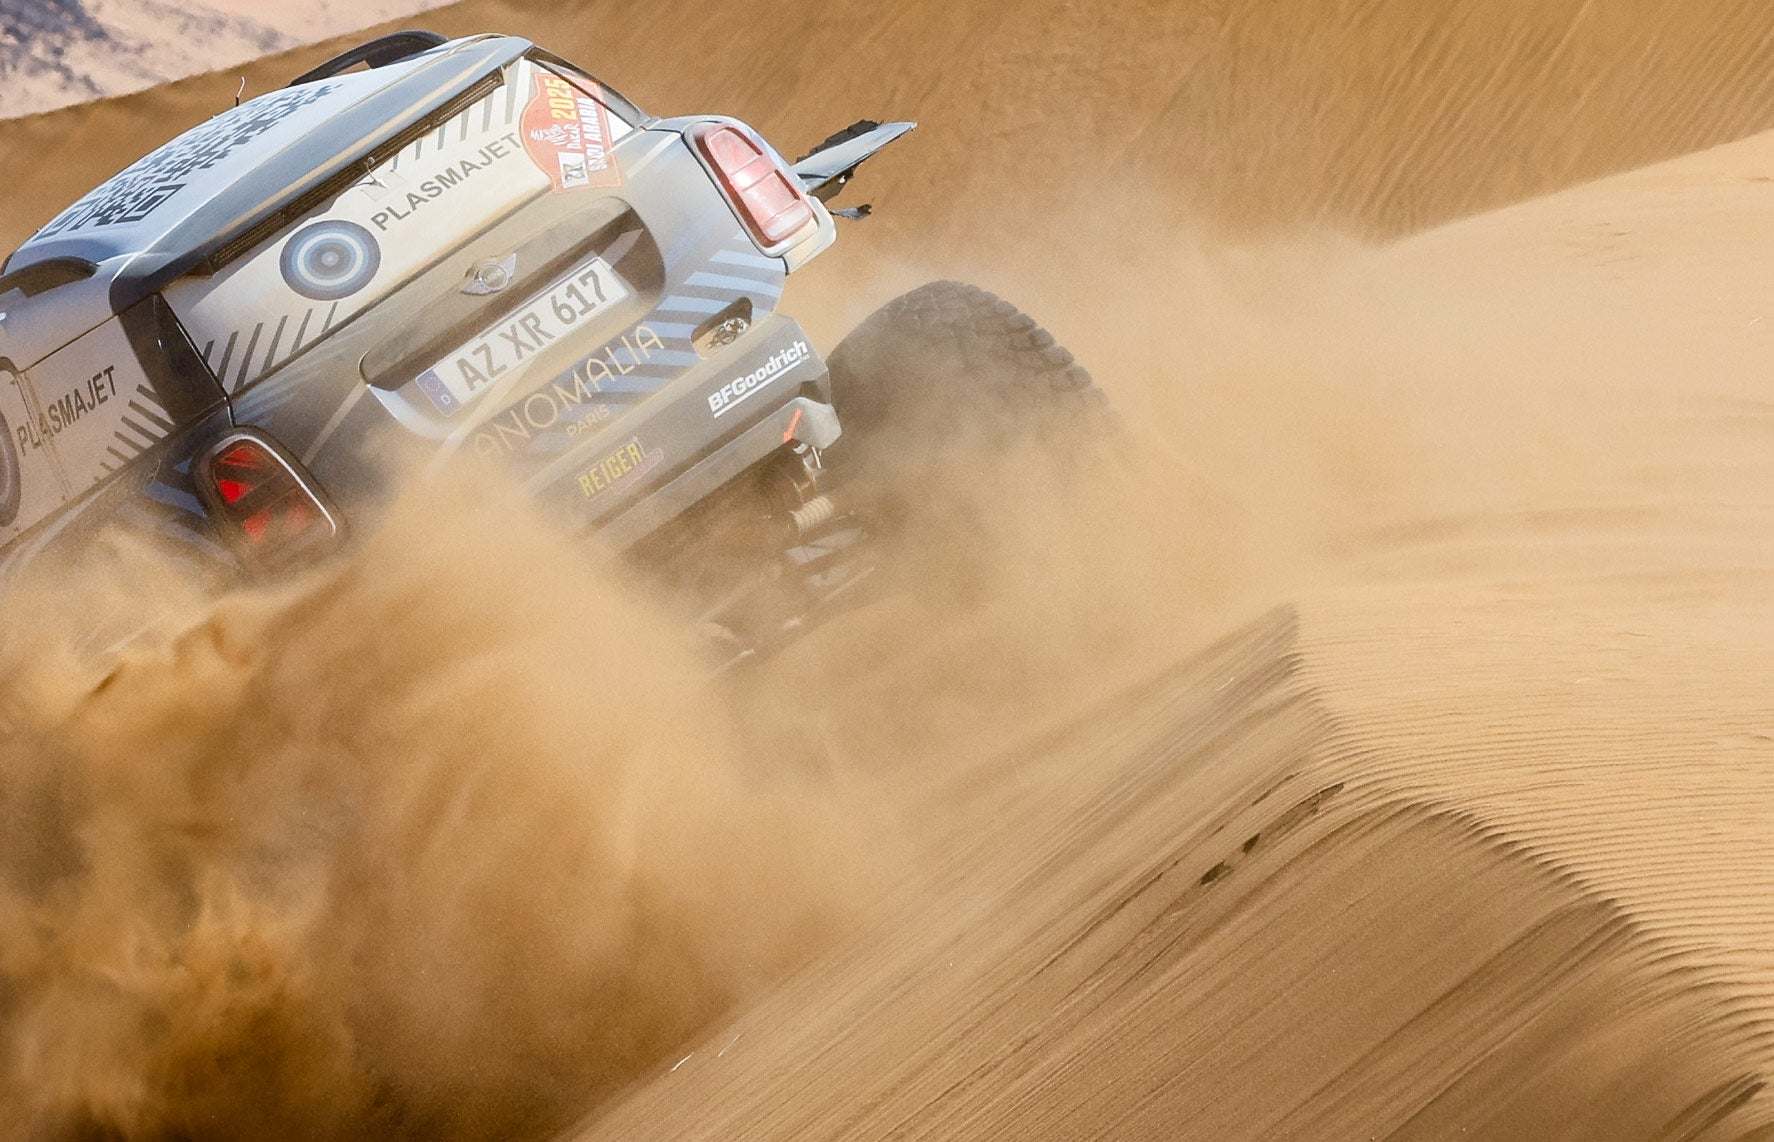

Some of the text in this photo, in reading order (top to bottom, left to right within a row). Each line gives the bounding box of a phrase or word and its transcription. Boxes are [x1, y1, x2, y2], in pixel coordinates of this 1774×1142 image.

[545, 79, 577, 120] 2025
[370, 132, 524, 231] PLASMAJET
[456, 269, 607, 392] AZ XR 617
[707, 340, 808, 413] BFGoodrich
[16, 365, 118, 457] PLASMAJET
[474, 325, 664, 454] ANOMALIA
